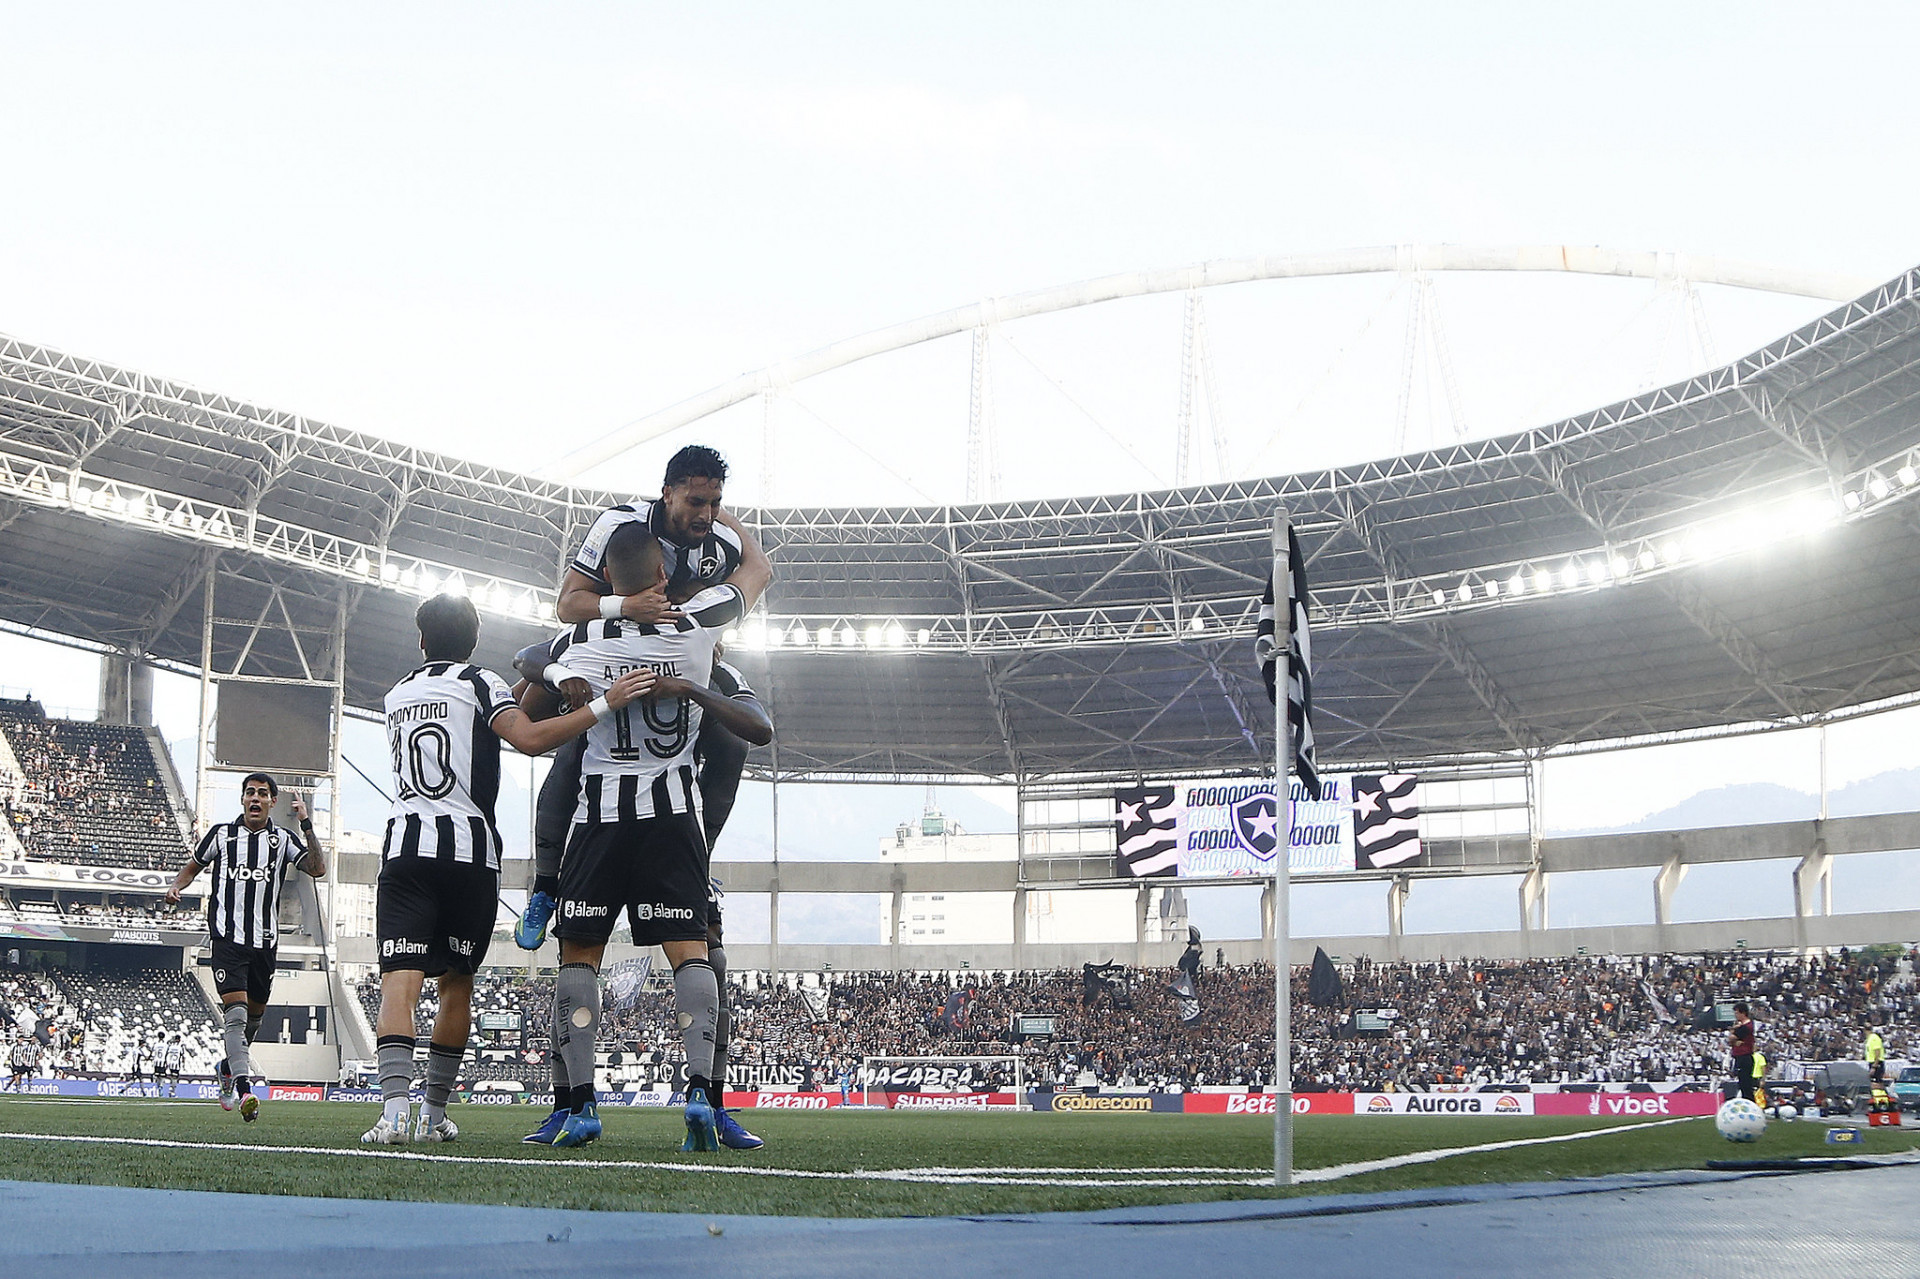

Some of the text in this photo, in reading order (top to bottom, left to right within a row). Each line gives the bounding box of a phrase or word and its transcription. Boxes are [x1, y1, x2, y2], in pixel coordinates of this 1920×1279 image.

[388, 702, 448, 729] MONTORO
[391, 722, 457, 801] 10
[228, 865, 272, 882] vbet
[575, 901, 607, 917] álamo
[654, 903, 693, 919] álamo
[272, 1089, 319, 1101] Betano
[471, 1093, 512, 1105] SICOOB
[530, 1094, 555, 1105] SICO
[603, 1092, 623, 1100] neo
[641, 1092, 661, 1100] neo
[756, 1093, 828, 1109] Betano
[1053, 1094, 1152, 1111] cobrecom
[1405, 1095, 1481, 1112] Aurora
[1606, 1095, 1669, 1114] vbet
